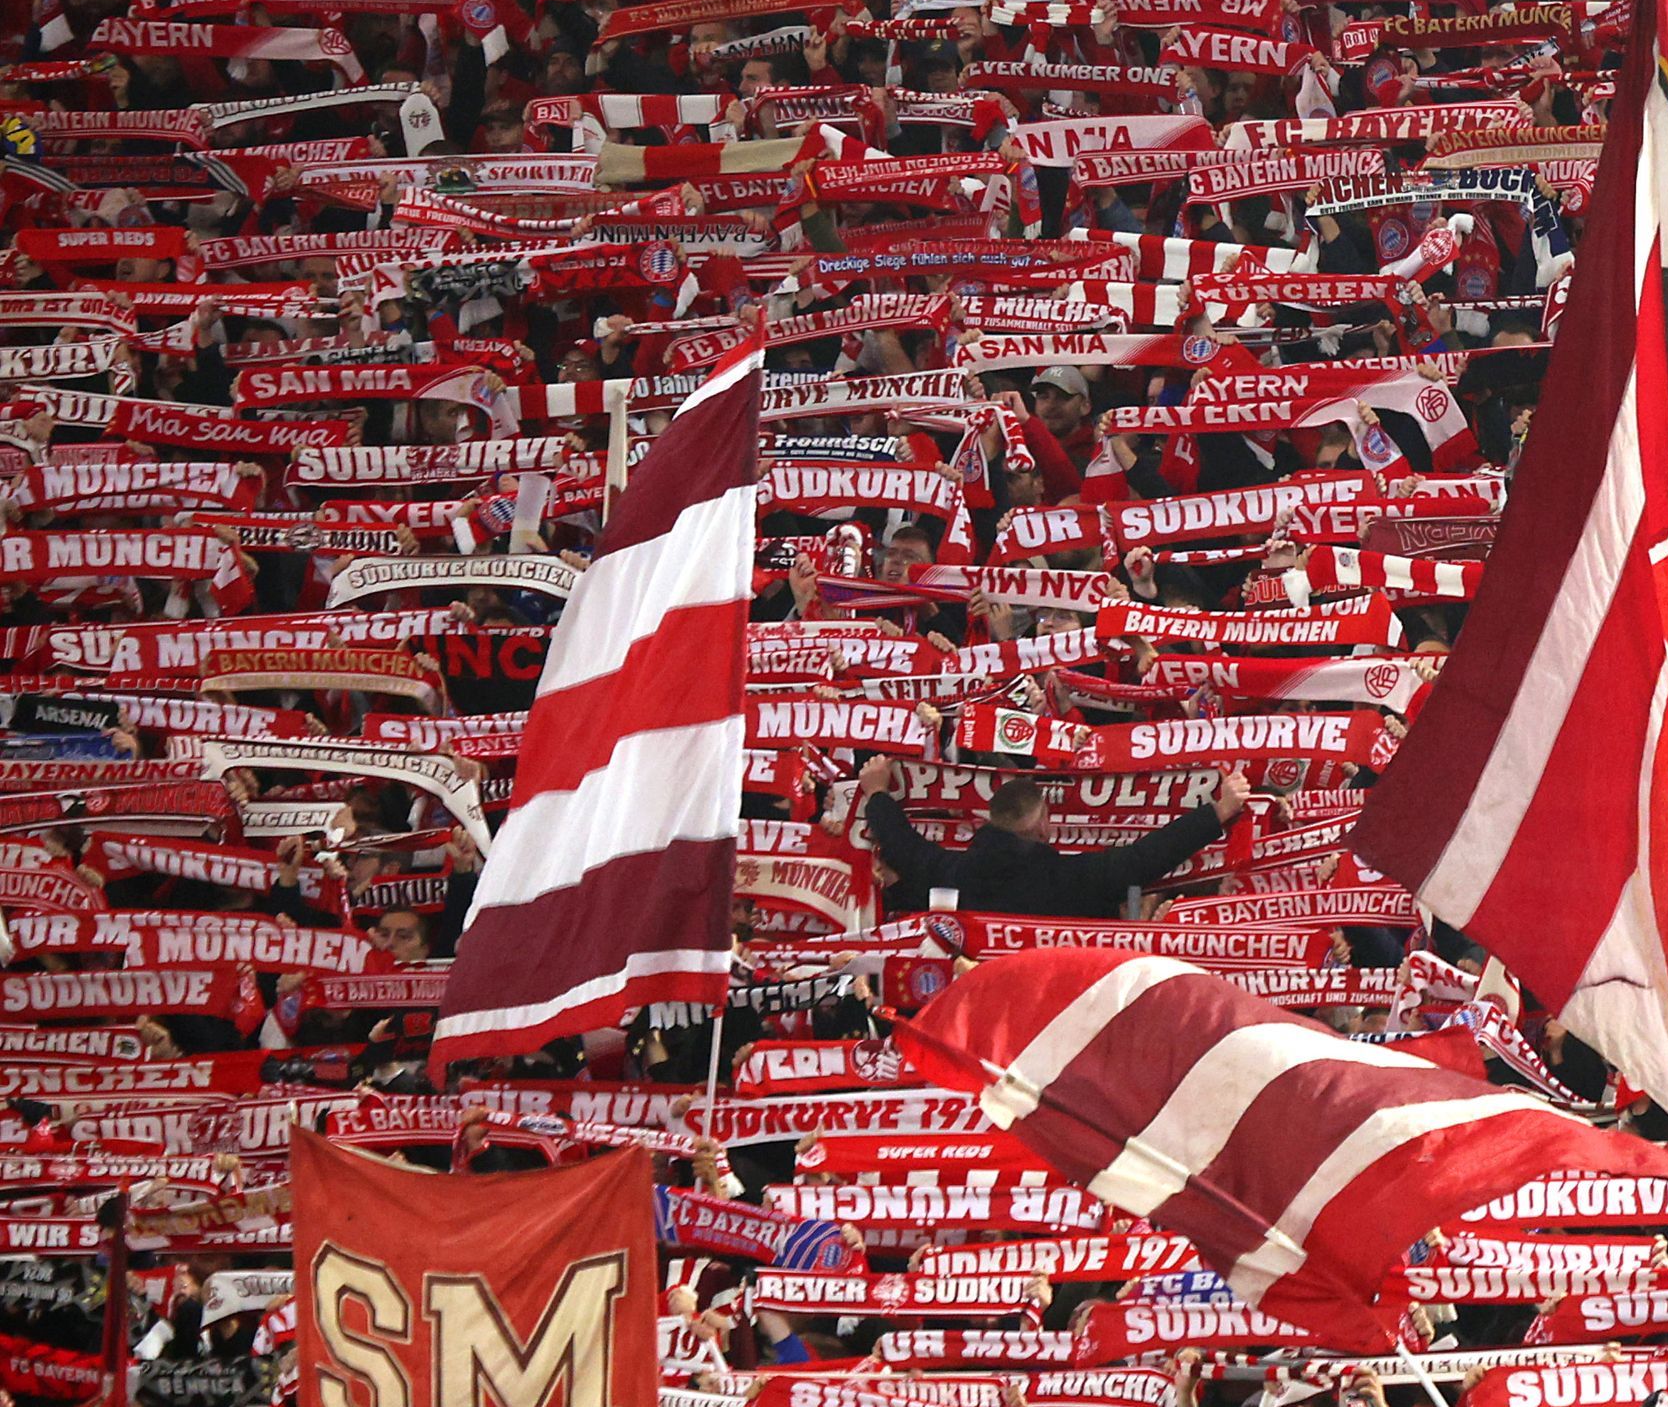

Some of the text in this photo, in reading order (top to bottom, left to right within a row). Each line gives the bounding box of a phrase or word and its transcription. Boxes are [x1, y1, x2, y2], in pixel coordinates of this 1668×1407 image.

[91, 18, 214, 48] BAYERN
[1045, 63, 1176, 87] NUMBER ONE
[487, 162, 595, 191] SPORTLER
[58, 228, 156, 247] SUPER REDS
[203, 228, 452, 265] FC BAYERN MÜNCHEN
[819, 251, 870, 272] Dreckige
[874, 252, 905, 269] Siege
[911, 250, 947, 267] fühlen
[253, 366, 412, 398] SAN MIA
[1118, 400, 1292, 430] BAYERN
[194, 419, 261, 444] san
[349, 558, 575, 590] SÜDKURVE MÜNCHEN
[1124, 609, 1339, 644] BAYERN MÜNCHEN
[218, 651, 307, 675] BAYERN
[1131, 715, 1350, 758] SÜDKURVE
[987, 924, 1310, 960] FC BAYERN MÜNCHEN
[4, 972, 215, 1011] SÜDKURVE
[311, 1240, 629, 1407] SM
